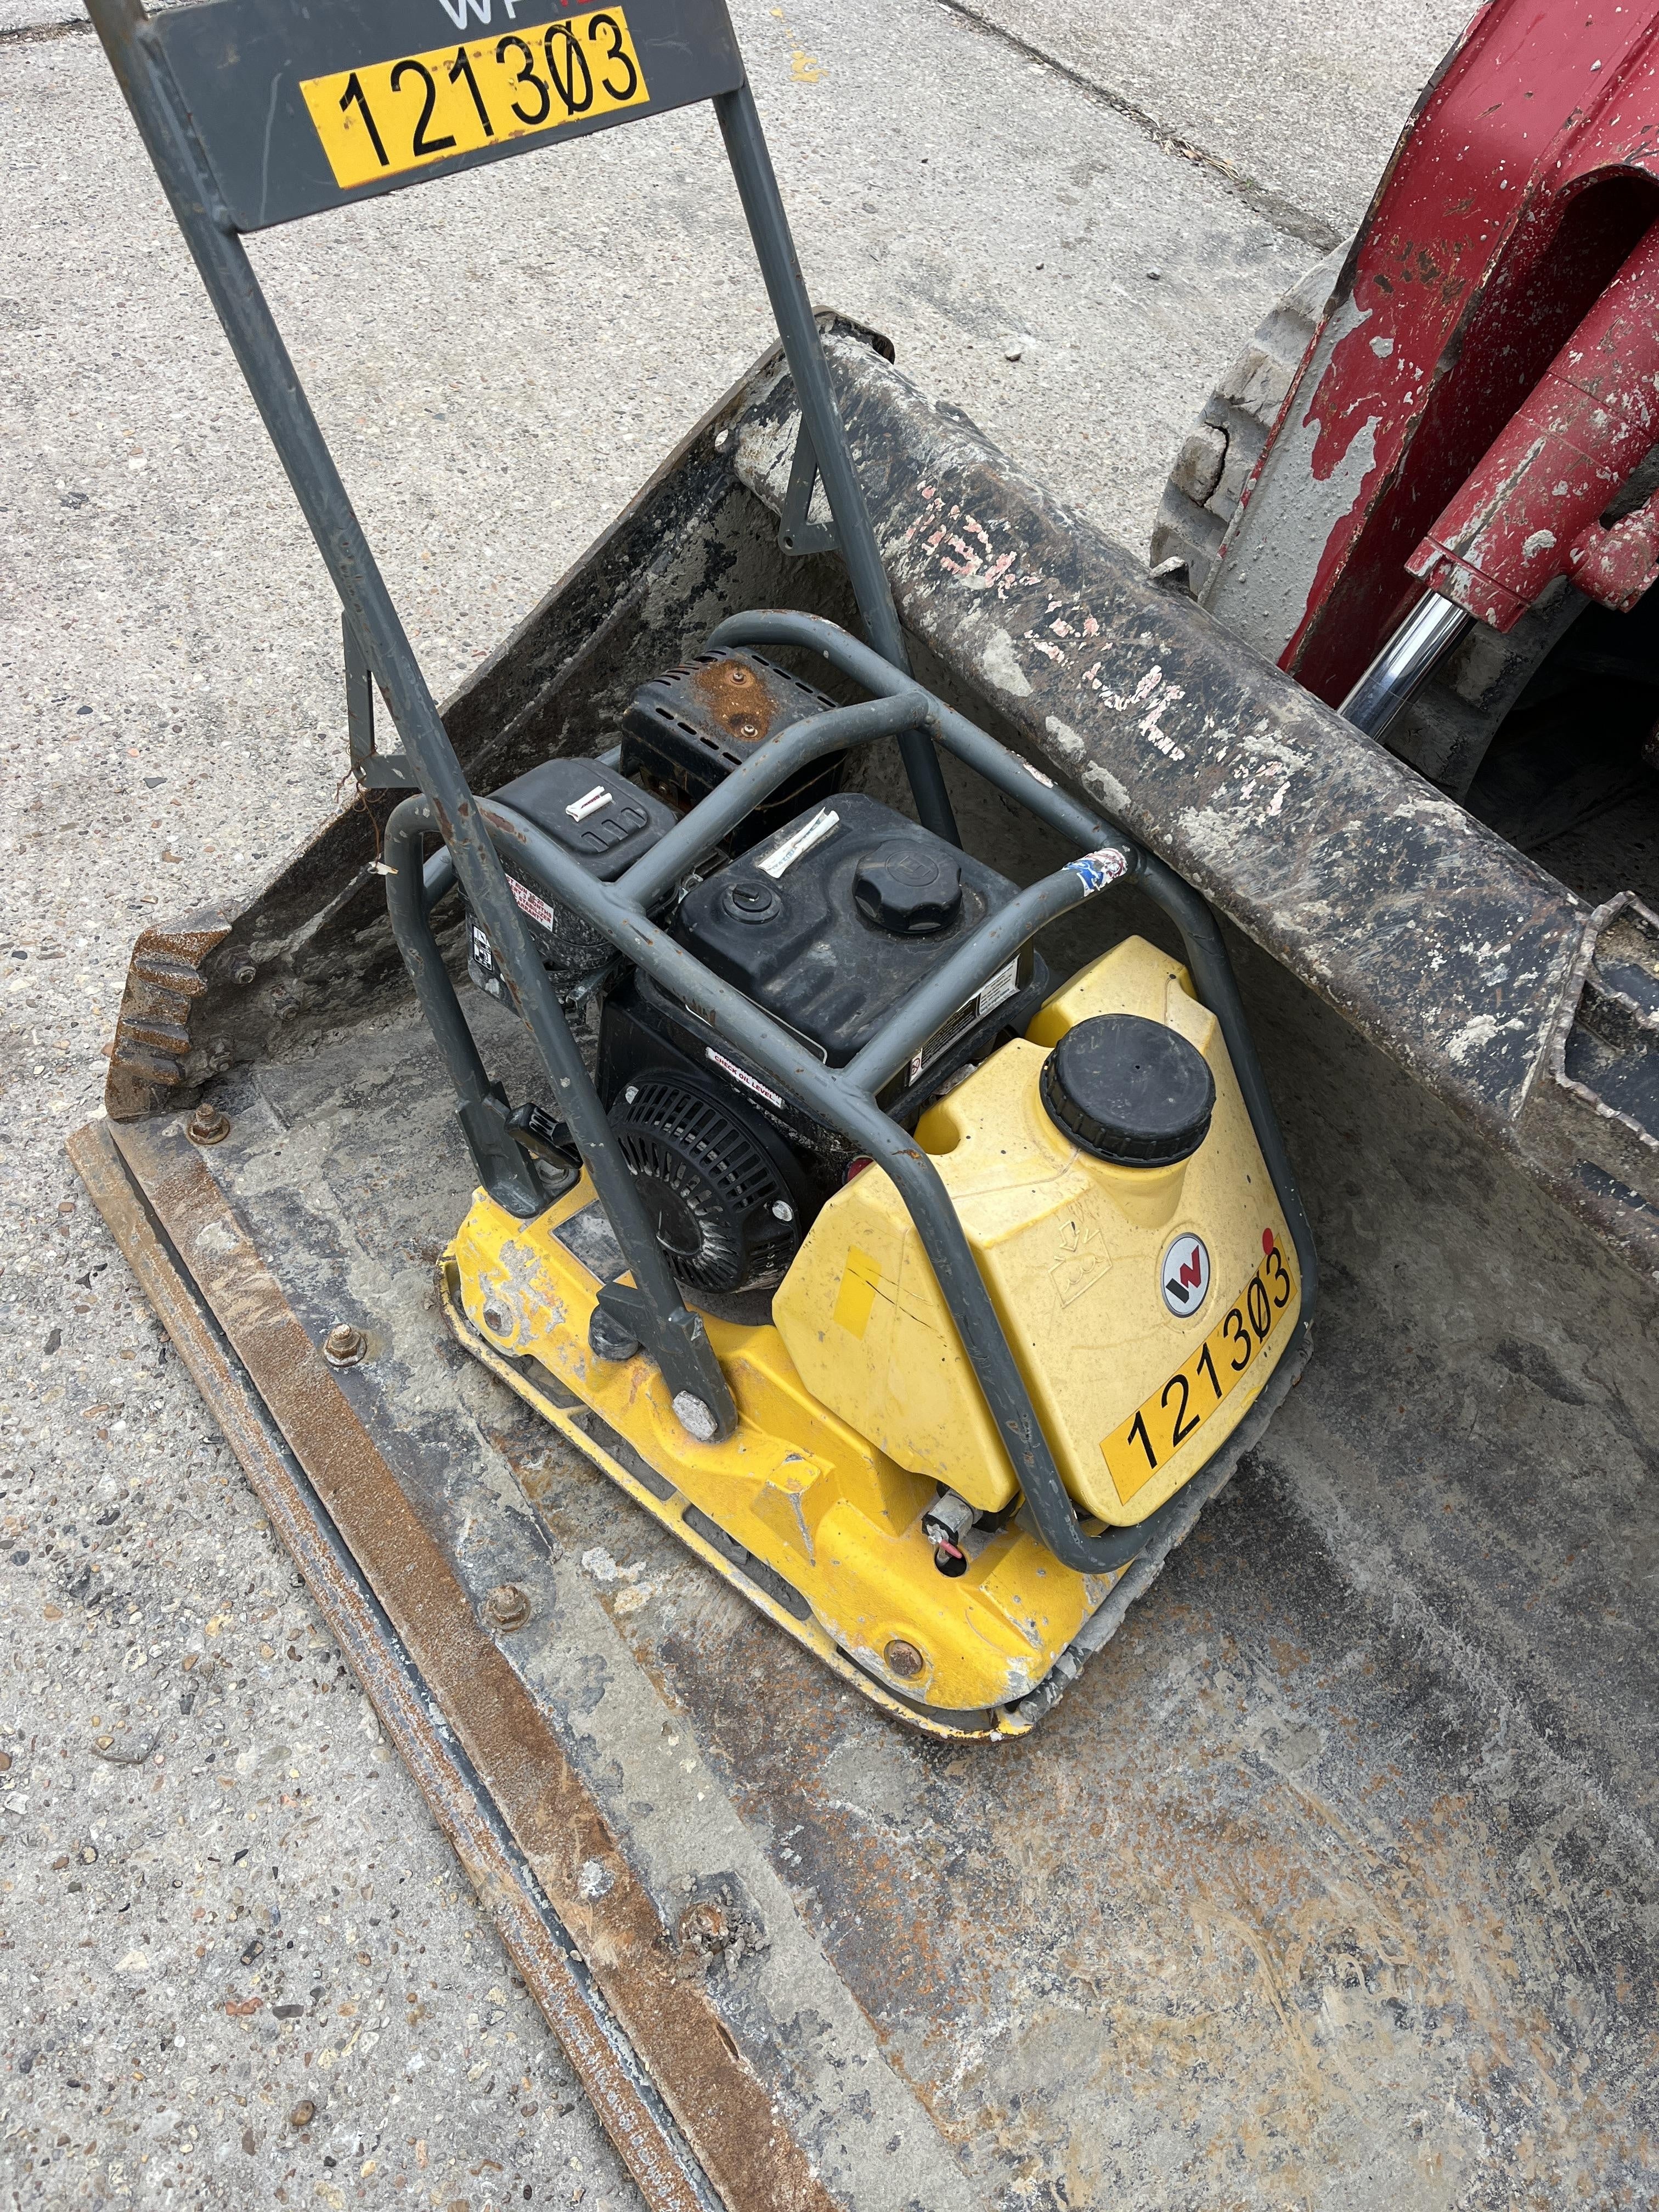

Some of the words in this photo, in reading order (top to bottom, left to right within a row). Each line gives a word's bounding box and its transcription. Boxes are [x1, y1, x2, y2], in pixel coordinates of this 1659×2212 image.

[340, 14, 637, 167] 121303
[516, 882, 527, 894] RUN
[517, 901, 543, 922] ARRANTY
[519, 896, 551, 924] STABILIZER
[528, 899, 552, 918] ONTHS
[714, 1056, 737, 1075] CHECK
[738, 1073, 751, 1084] OIL
[1127, 1247, 1290, 1469] 121303
